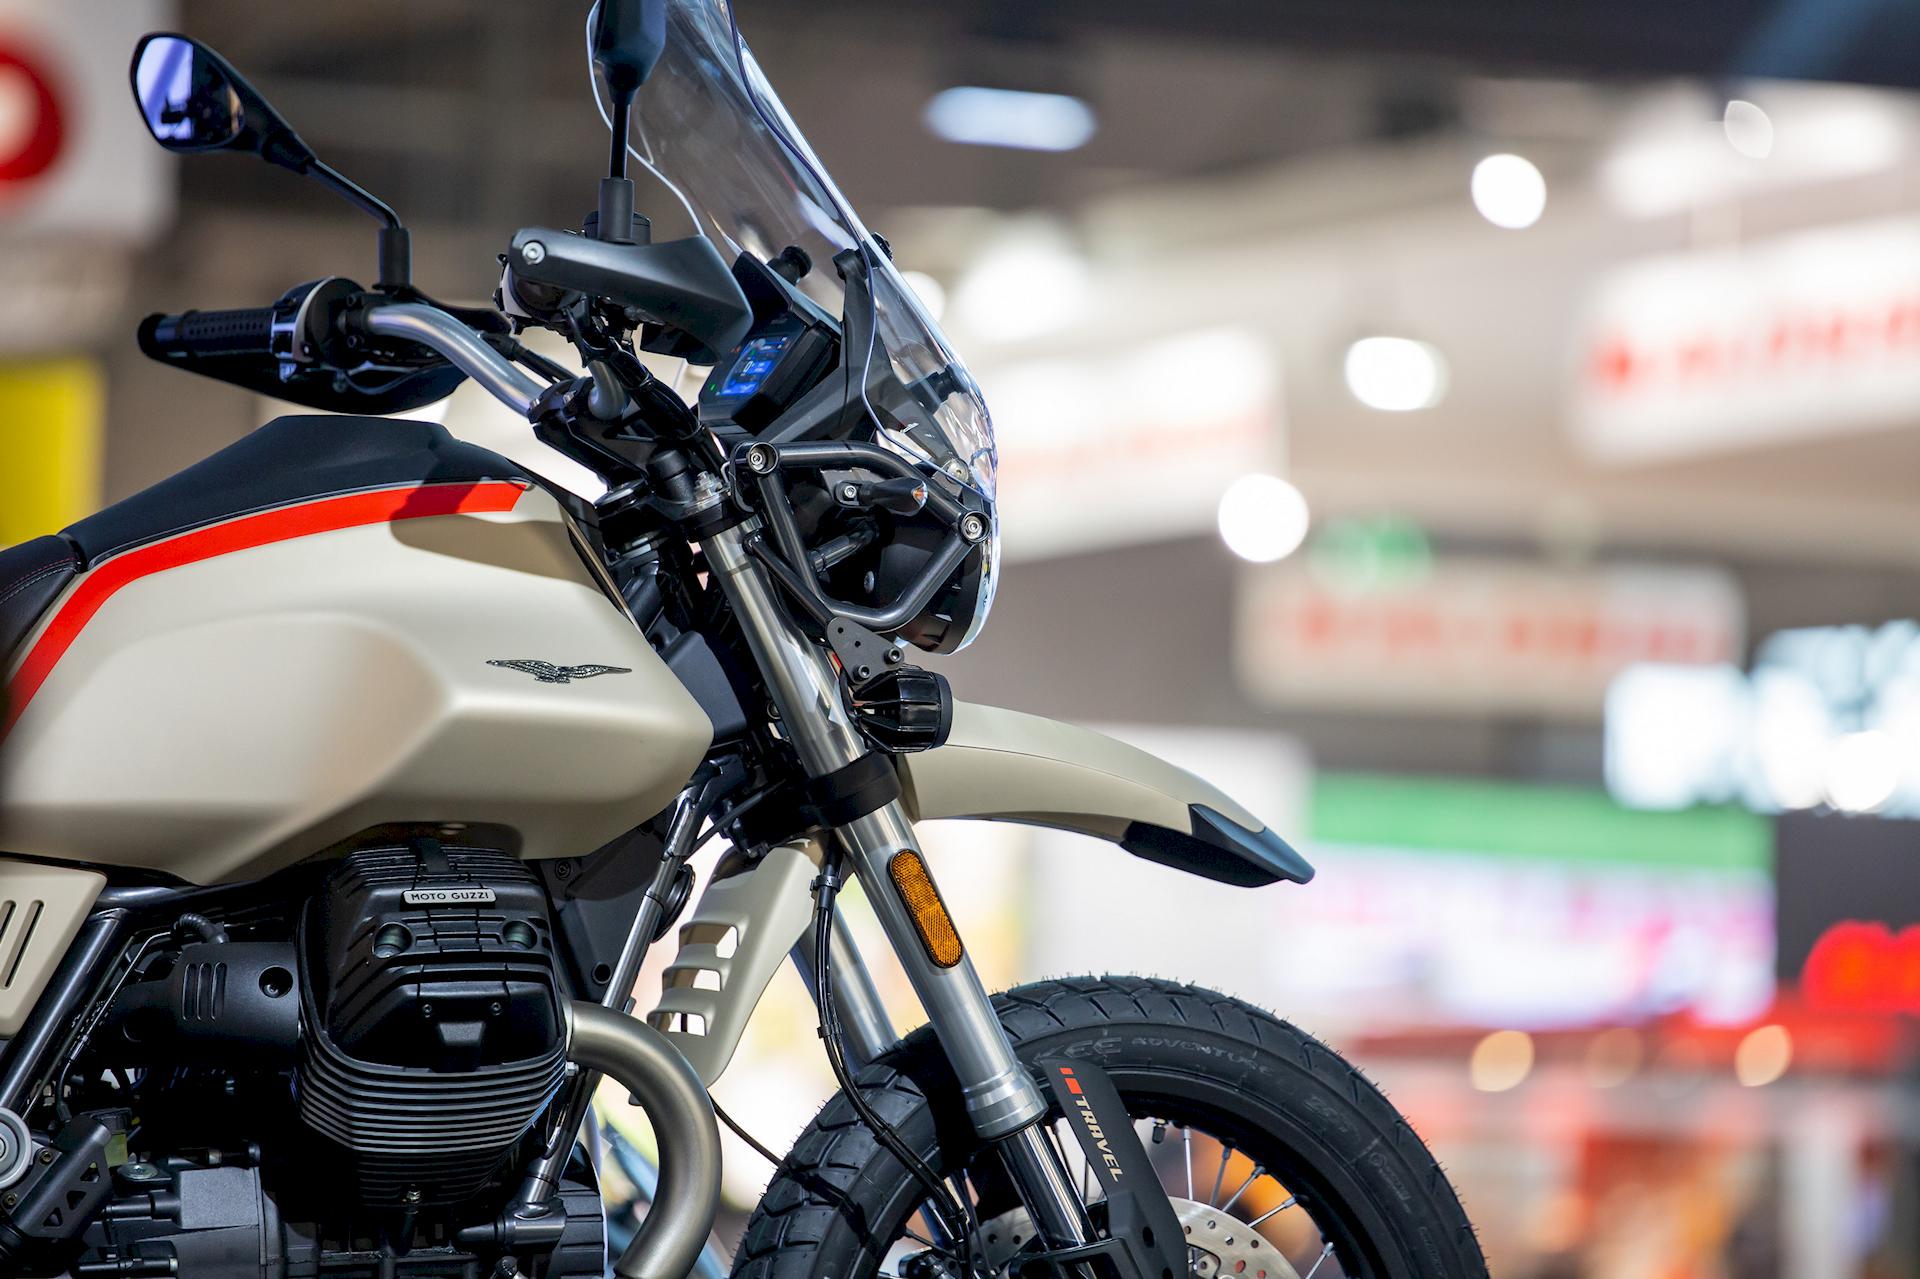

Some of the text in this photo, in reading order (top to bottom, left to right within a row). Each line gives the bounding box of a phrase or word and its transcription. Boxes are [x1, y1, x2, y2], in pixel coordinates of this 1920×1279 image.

[411, 891, 489, 901] MOTO GUZZI
[1131, 1037, 1274, 1076] ADVENTURE
[1075, 1095, 1124, 1183] TRAVEL
